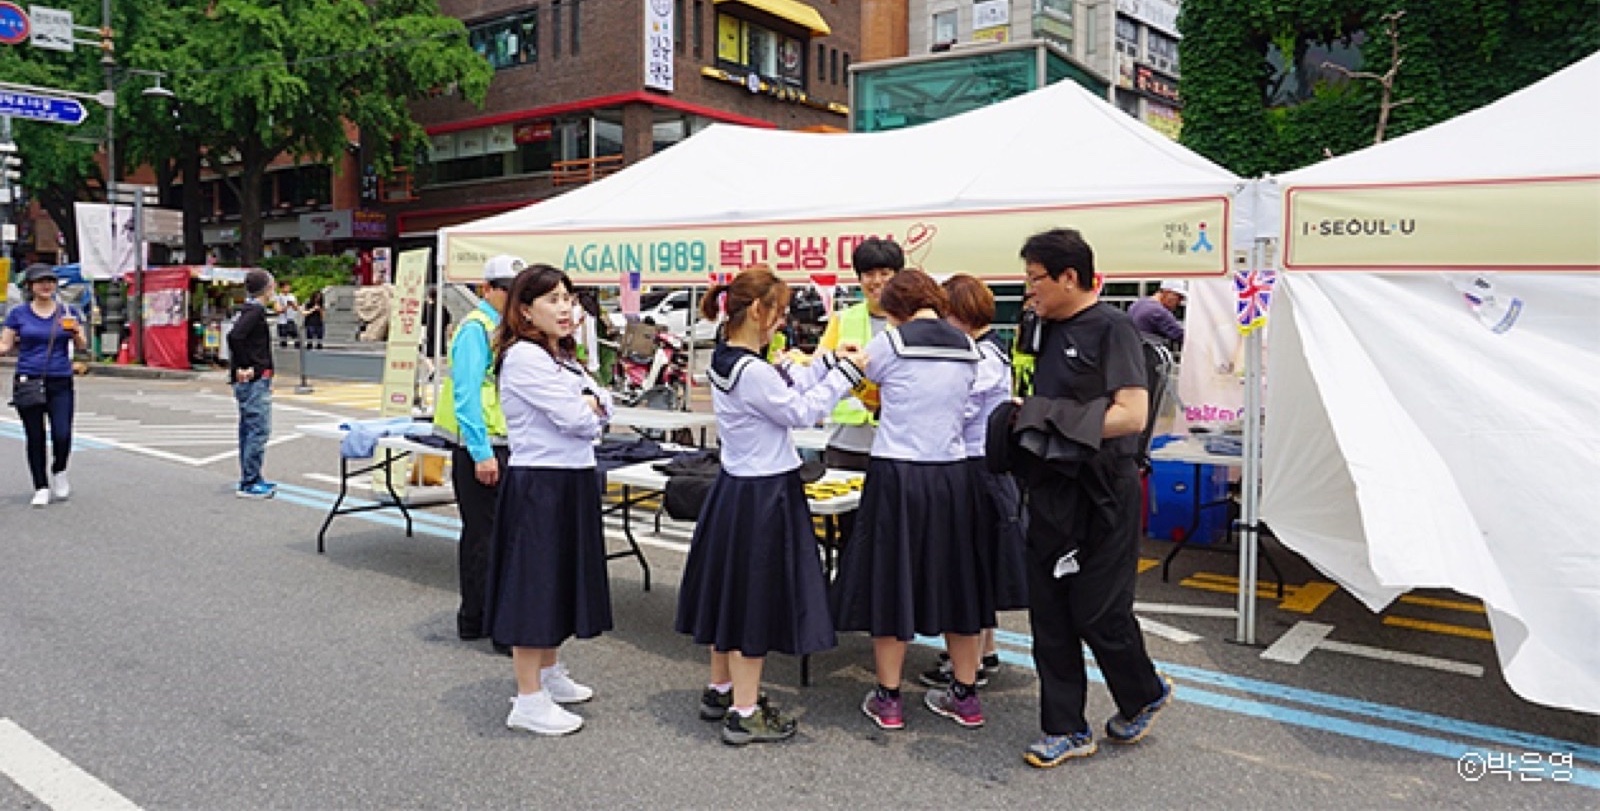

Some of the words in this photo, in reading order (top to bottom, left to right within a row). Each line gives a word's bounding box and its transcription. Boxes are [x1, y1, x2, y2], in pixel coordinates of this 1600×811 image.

[563, 243, 642, 273] AGAIN
[648, 240, 714, 273] 1989.
[719, 238, 768, 270] 복고
[774, 236, 829, 270] 의상
